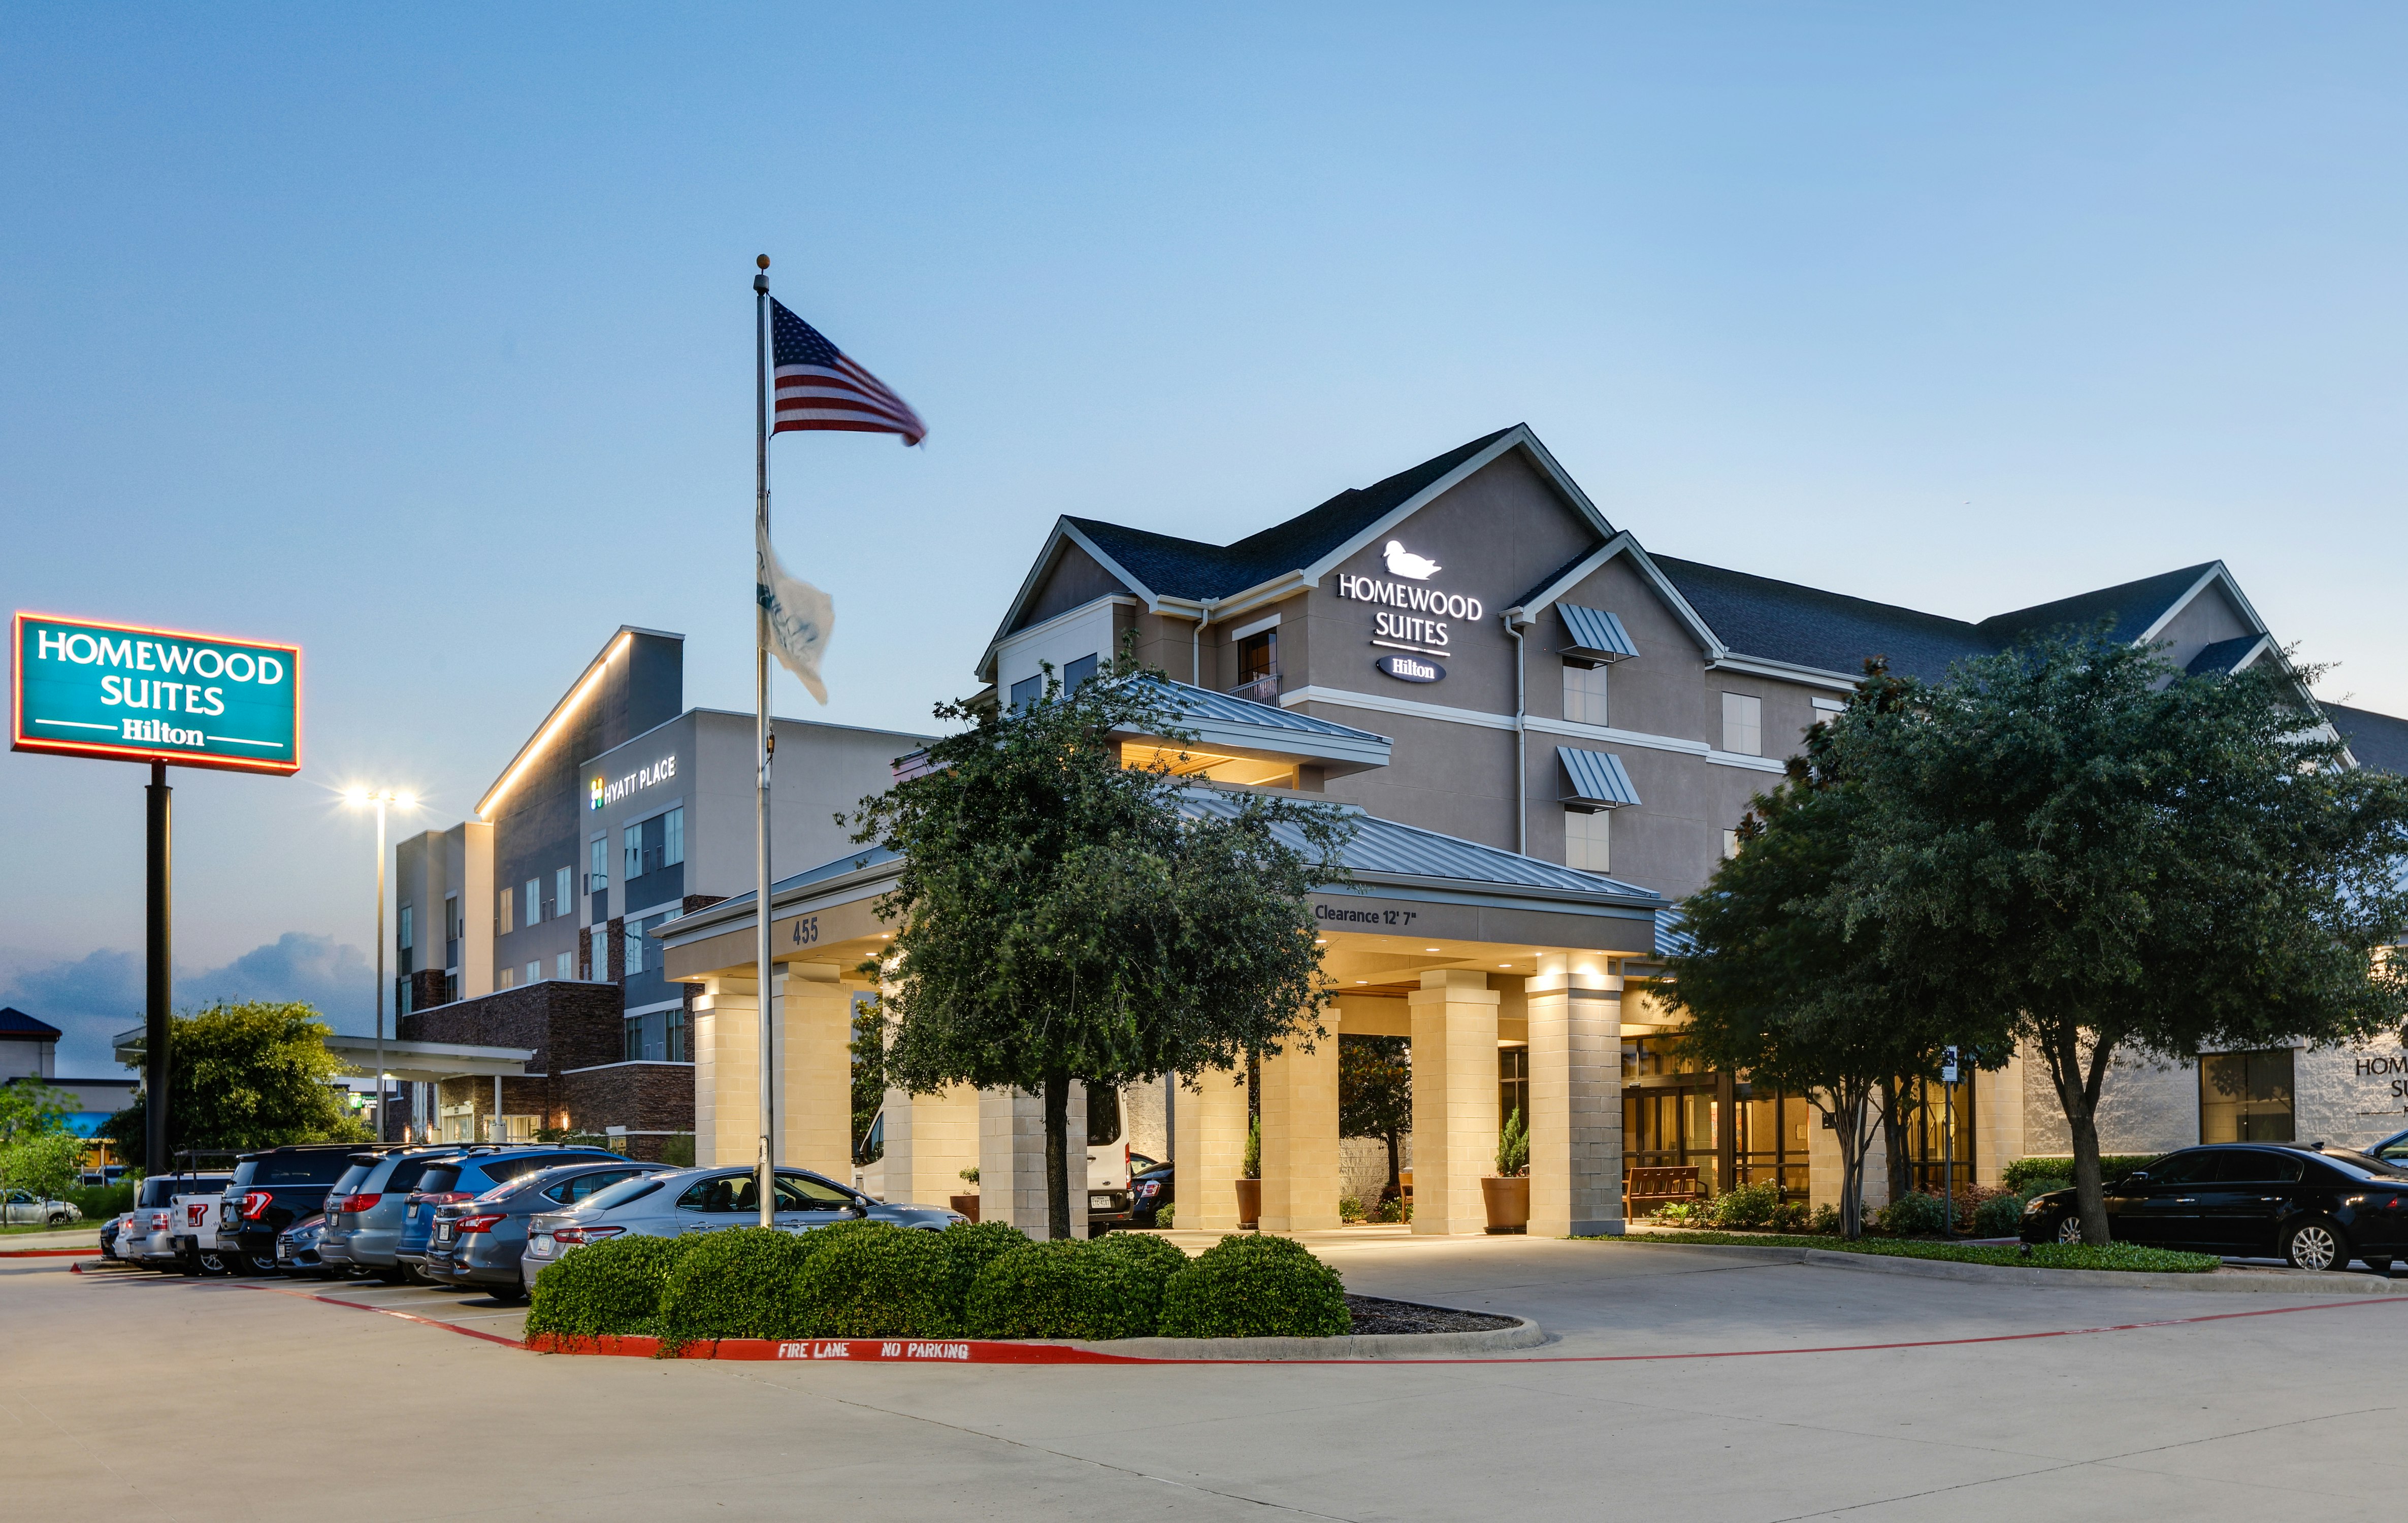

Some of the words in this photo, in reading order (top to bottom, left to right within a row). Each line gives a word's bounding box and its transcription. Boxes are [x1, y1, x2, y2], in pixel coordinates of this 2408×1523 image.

[1339, 573, 1482, 620] HOMEWOOD
[1375, 612, 1448, 646] SUITES
[38, 630, 283, 684] HOMEWOOD
[1392, 658, 1435, 679] Hilton
[101, 675, 225, 716] SUITES
[122, 718, 205, 747] Hilton
[604, 773, 637, 805] HYATT
[640, 755, 676, 789] PLACE
[793, 916, 818, 945] 455
[1315, 905, 1379, 923] Clearance
[1383, 910, 1399, 925] 12'
[1403, 912, 1417, 925] 7"
[778, 1342, 809, 1358] FIRE
[813, 1342, 850, 1358] LANE
[882, 1342, 901, 1357] NO
[907, 1343, 969, 1359] PARKING
